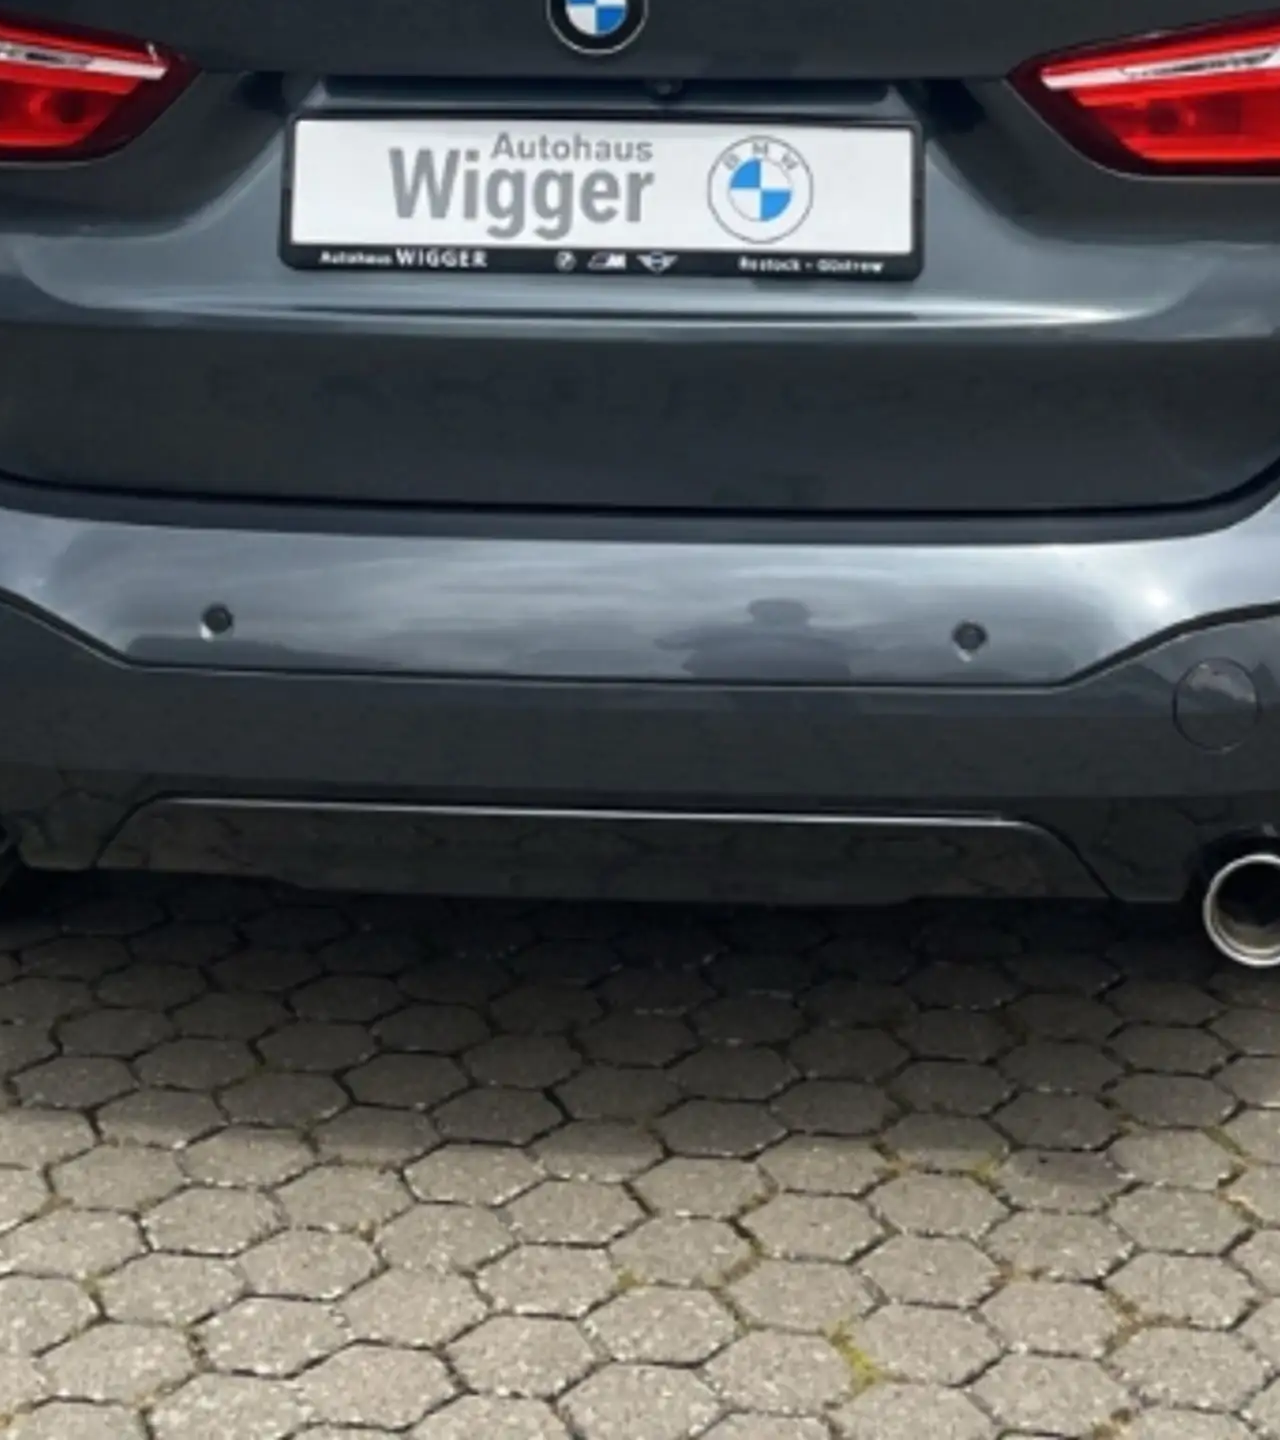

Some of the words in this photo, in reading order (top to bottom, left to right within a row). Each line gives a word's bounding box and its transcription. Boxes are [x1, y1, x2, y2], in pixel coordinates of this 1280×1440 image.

[489, 131, 654, 162] Autohaus
[388, 146, 656, 241] Wigger
[395, 247, 488, 269] WIGGER
